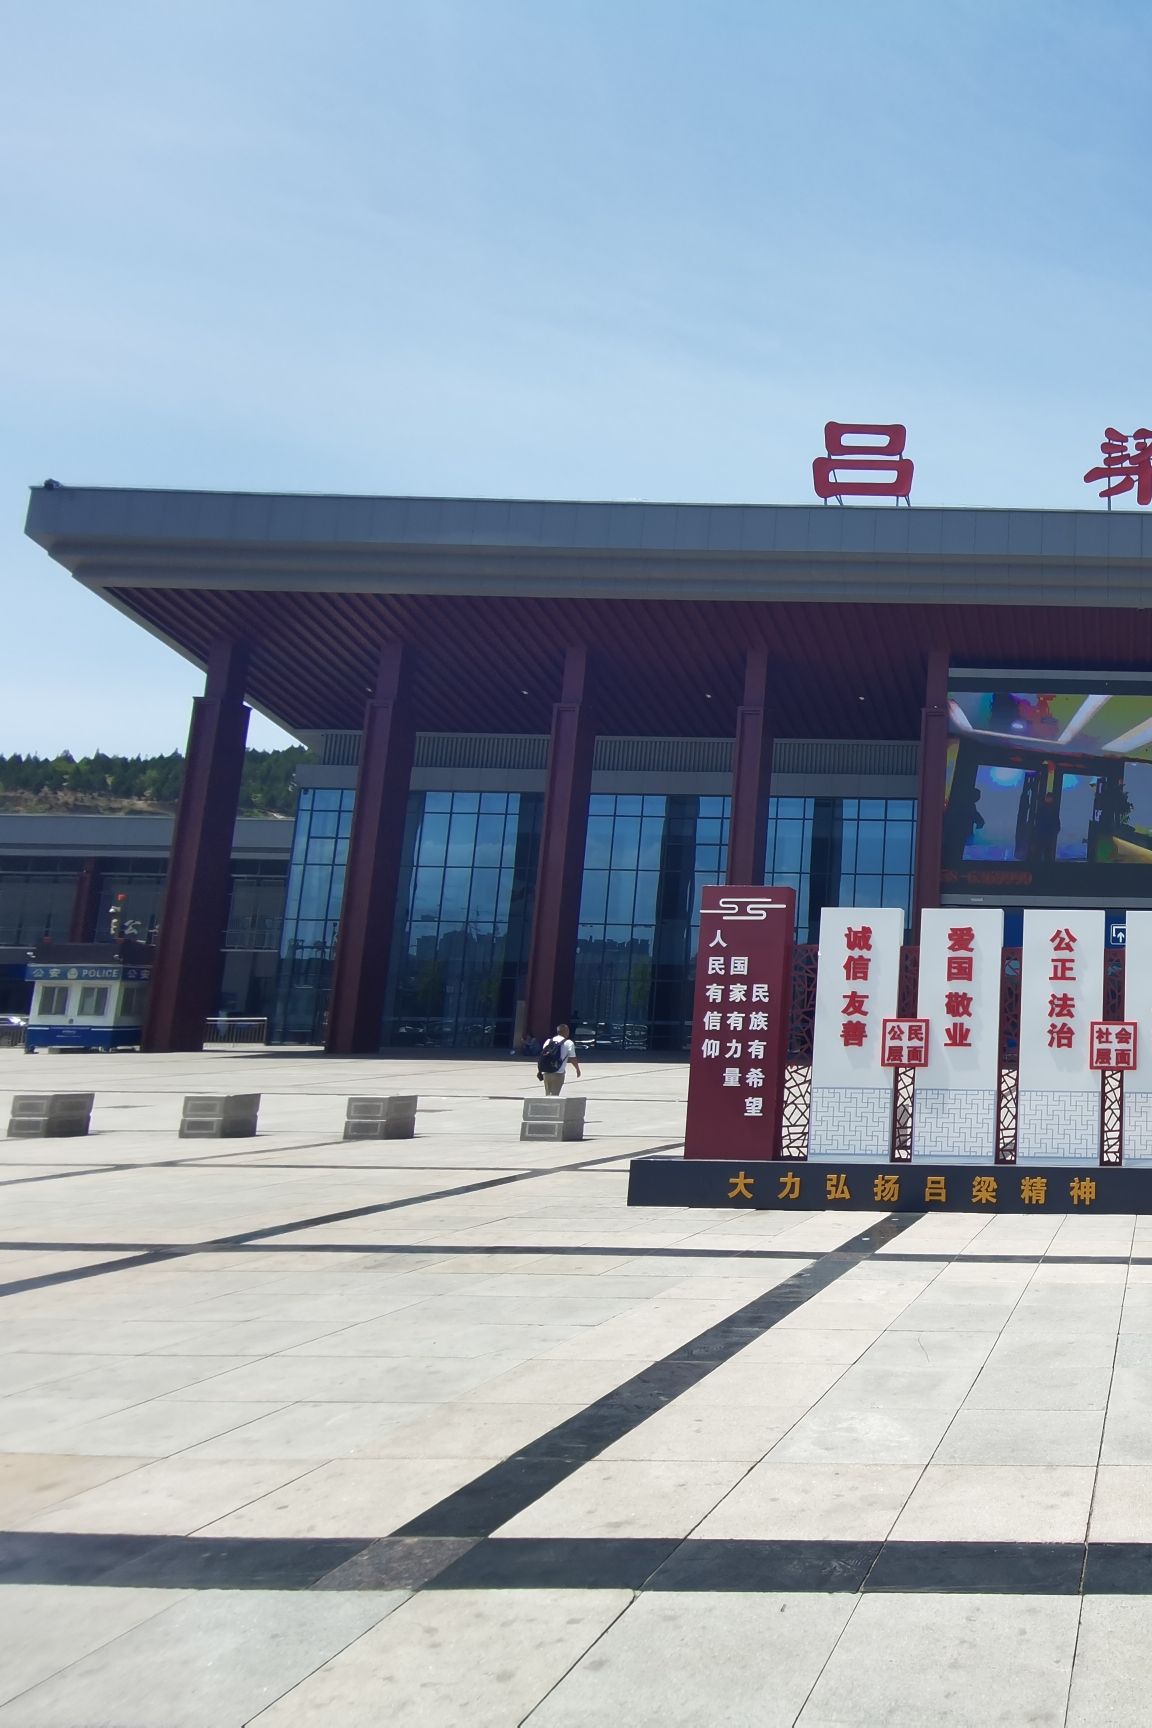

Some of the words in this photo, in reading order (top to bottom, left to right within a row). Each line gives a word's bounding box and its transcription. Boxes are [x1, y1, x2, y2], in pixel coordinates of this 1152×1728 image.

[32, 968, 61, 978] 公安
[81, 969, 119, 978] POLICE
[840, 926, 873, 1048] 诚信友善
[943, 926, 975, 1048] 爱国敬业
[1047, 928, 1077, 1049] 公正法治
[701, 929, 728, 1059] 人民有信仰
[722, 956, 749, 1087] 国家有力量
[889, 1024, 923, 1041] 公民
[1096, 1028, 1132, 1045] 社会
[743, 983, 770, 1117] 民族有希望
[886, 1045, 924, 1063] 层面
[1094, 1048, 1132, 1066] 层面
[728, 1171, 1097, 1206] 大力弘扬吕梁精神
